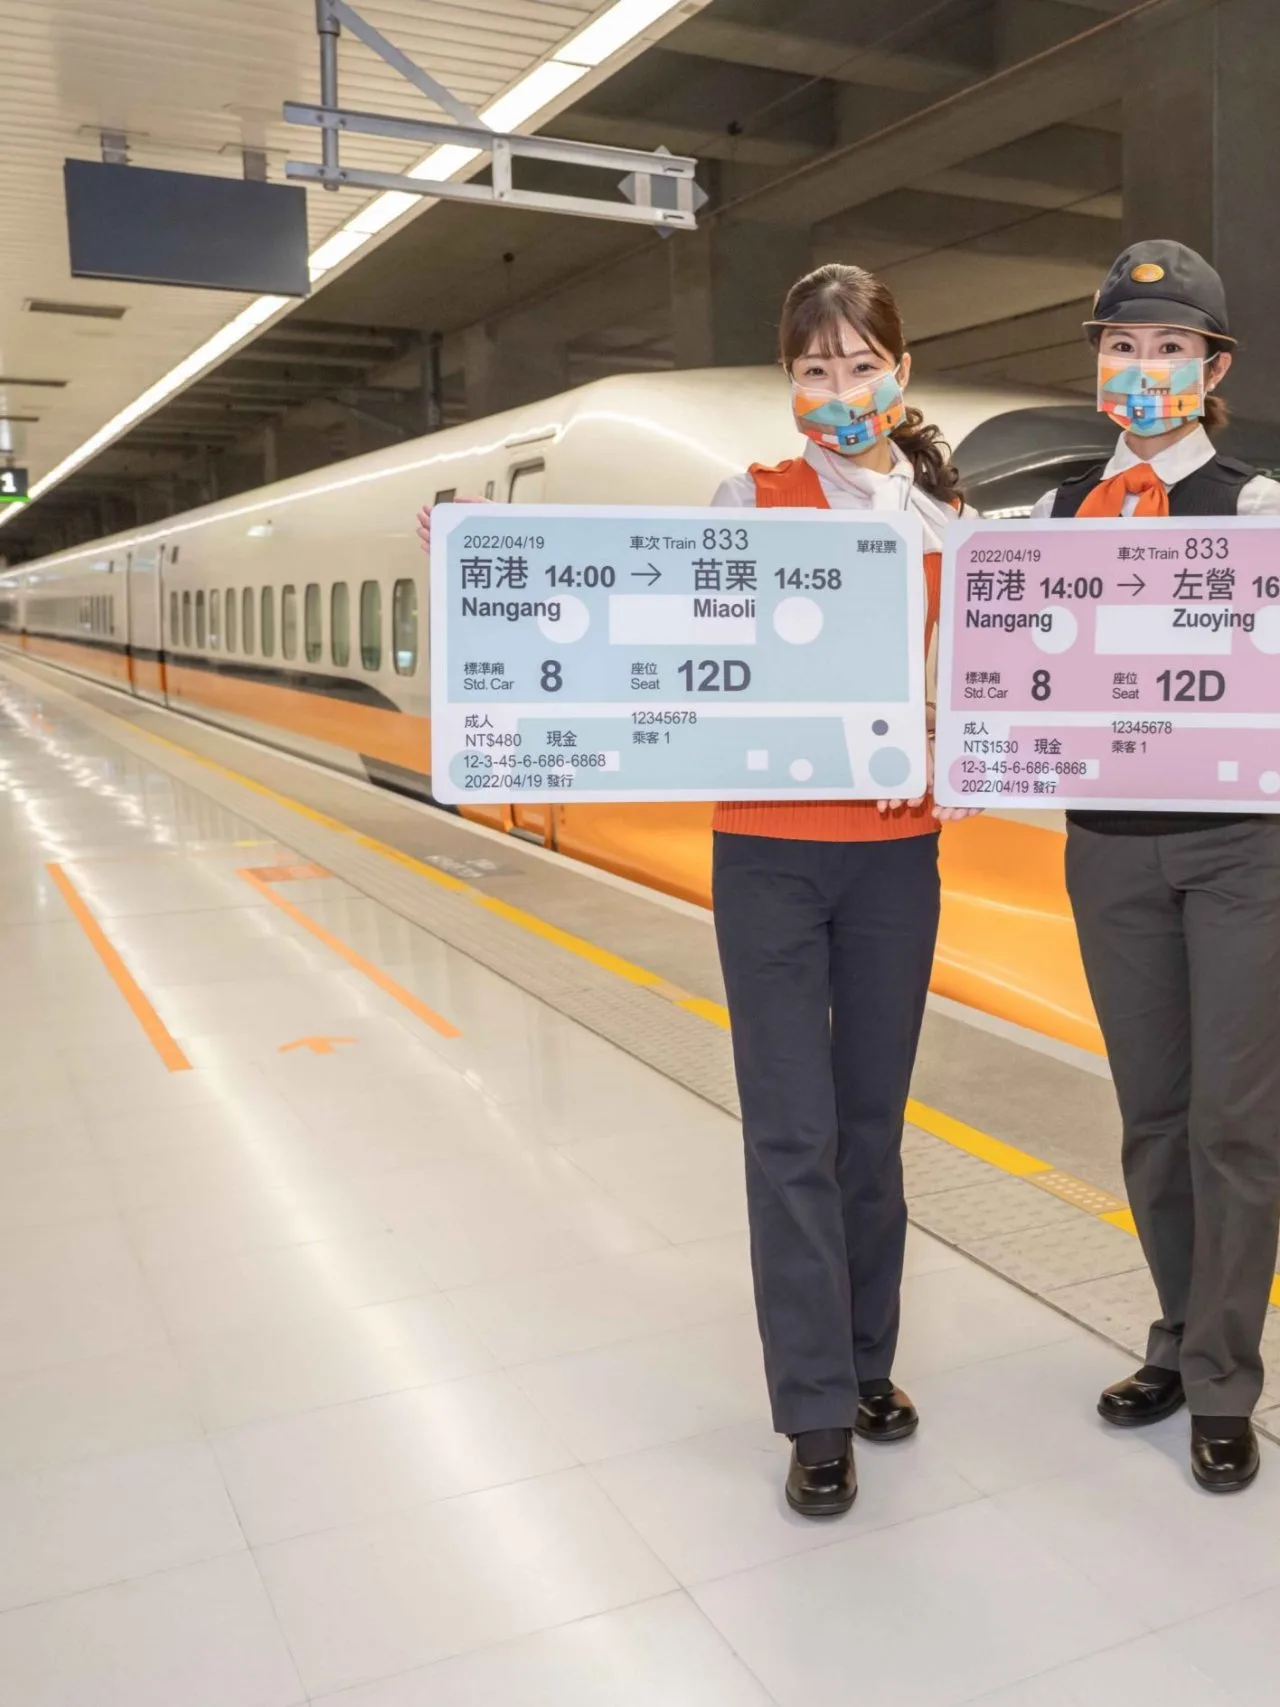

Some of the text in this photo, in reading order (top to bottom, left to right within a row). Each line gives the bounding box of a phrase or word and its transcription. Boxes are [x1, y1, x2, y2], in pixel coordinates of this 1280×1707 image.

[0, 471, 17, 493] 1
[463, 535, 545, 550] 2022/04/19
[629, 527, 749, 551] 車次 Train 833
[970, 548, 1042, 564] 2022/04/19
[1116, 536, 1230, 562] 車次 Train 833
[459, 555, 616, 590] 南港 14:00
[690, 557, 843, 592] 苗栗 14:58
[966, 568, 1104, 603] 南港 14:00
[1172, 567, 1236, 601] 左營
[461, 596, 561, 623] Nangang
[693, 597, 756, 619] Miaoli
[965, 608, 1053, 633] Nangang
[1171, 607, 1256, 633] Zuoying
[539, 659, 564, 693] 8
[630, 661, 659, 676] 座位
[677, 659, 752, 692] 12D
[463, 677, 515, 691] Std. Car
[630, 677, 661, 691] Seat
[1030, 668, 1052, 702] 8
[1112, 671, 1138, 685] 座位
[1155, 669, 1226, 702] 12D
[964, 686, 1009, 700] Std. Car
[1111, 687, 1140, 700] Seat
[464, 713, 494, 729] 成人
[631, 710, 698, 725] 12345678
[962, 720, 990, 736] 成人
[1111, 720, 1173, 735] 12345678
[465, 729, 578, 748] NT$480 現金
[663, 731, 670, 744] 1
[963, 737, 1063, 755] NT$1530 現金
[1140, 740, 1147, 753] 1
[463, 753, 607, 769] 12-3-45-6-686-6868
[960, 760, 1088, 775] 12-3-45-6-686-6868
[464, 773, 574, 789] 2022/04/19 發行
[961, 778, 1057, 795] 2022/04/19 發行
